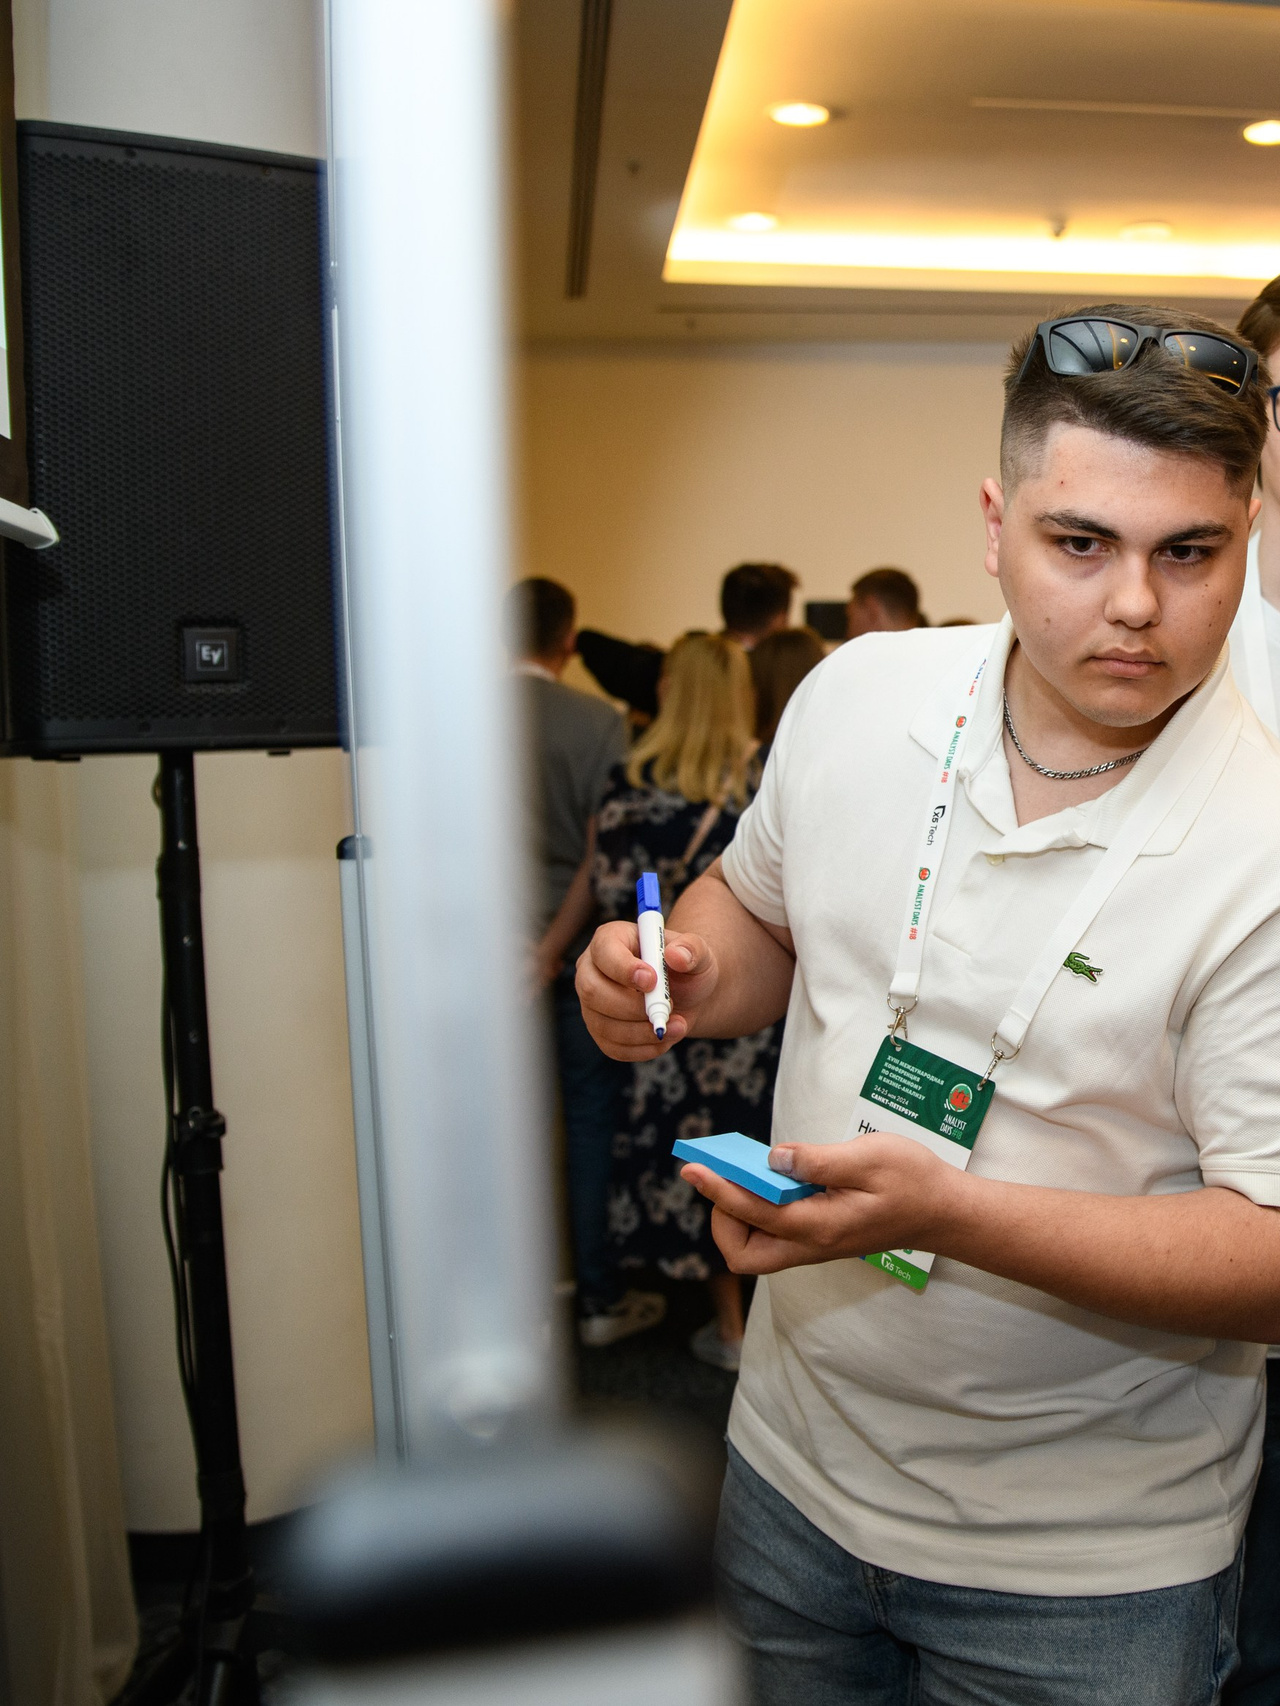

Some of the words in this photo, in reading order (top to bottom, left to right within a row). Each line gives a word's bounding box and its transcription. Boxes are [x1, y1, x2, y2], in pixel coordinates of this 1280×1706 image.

[948, 731, 961, 756] ANALYST
[944, 756, 954, 770] DAYS
[940, 771, 949, 783] #18
[926, 825, 938, 846] Tech
[914, 884, 926, 911] ANALYST
[911, 911, 921, 926] DAYS
[909, 927, 918, 941] #18
[881, 1068, 890, 1076] ПО
[889, 1072, 923, 1092] СИСТЕМНОМУ
[883, 1061, 921, 1083] КОНФЕРЕНЦИЯ
[899, 1061, 945, 1086] МЕЖДУНАРОДНАЯ
[873, 1084, 889, 1096] 24-25
[896, 1095, 910, 1106] 2024
[882, 1077, 926, 1101] БИЗНЕС-АНАЛИЗУ
[870, 1092, 919, 1119] САНКТ-ПЕТЕРБУРГ
[939, 1122, 954, 1136] DAYS
[952, 1128, 964, 1140] #18
[943, 1113, 968, 1131] ANALYST
[895, 1265, 912, 1281] Tech
